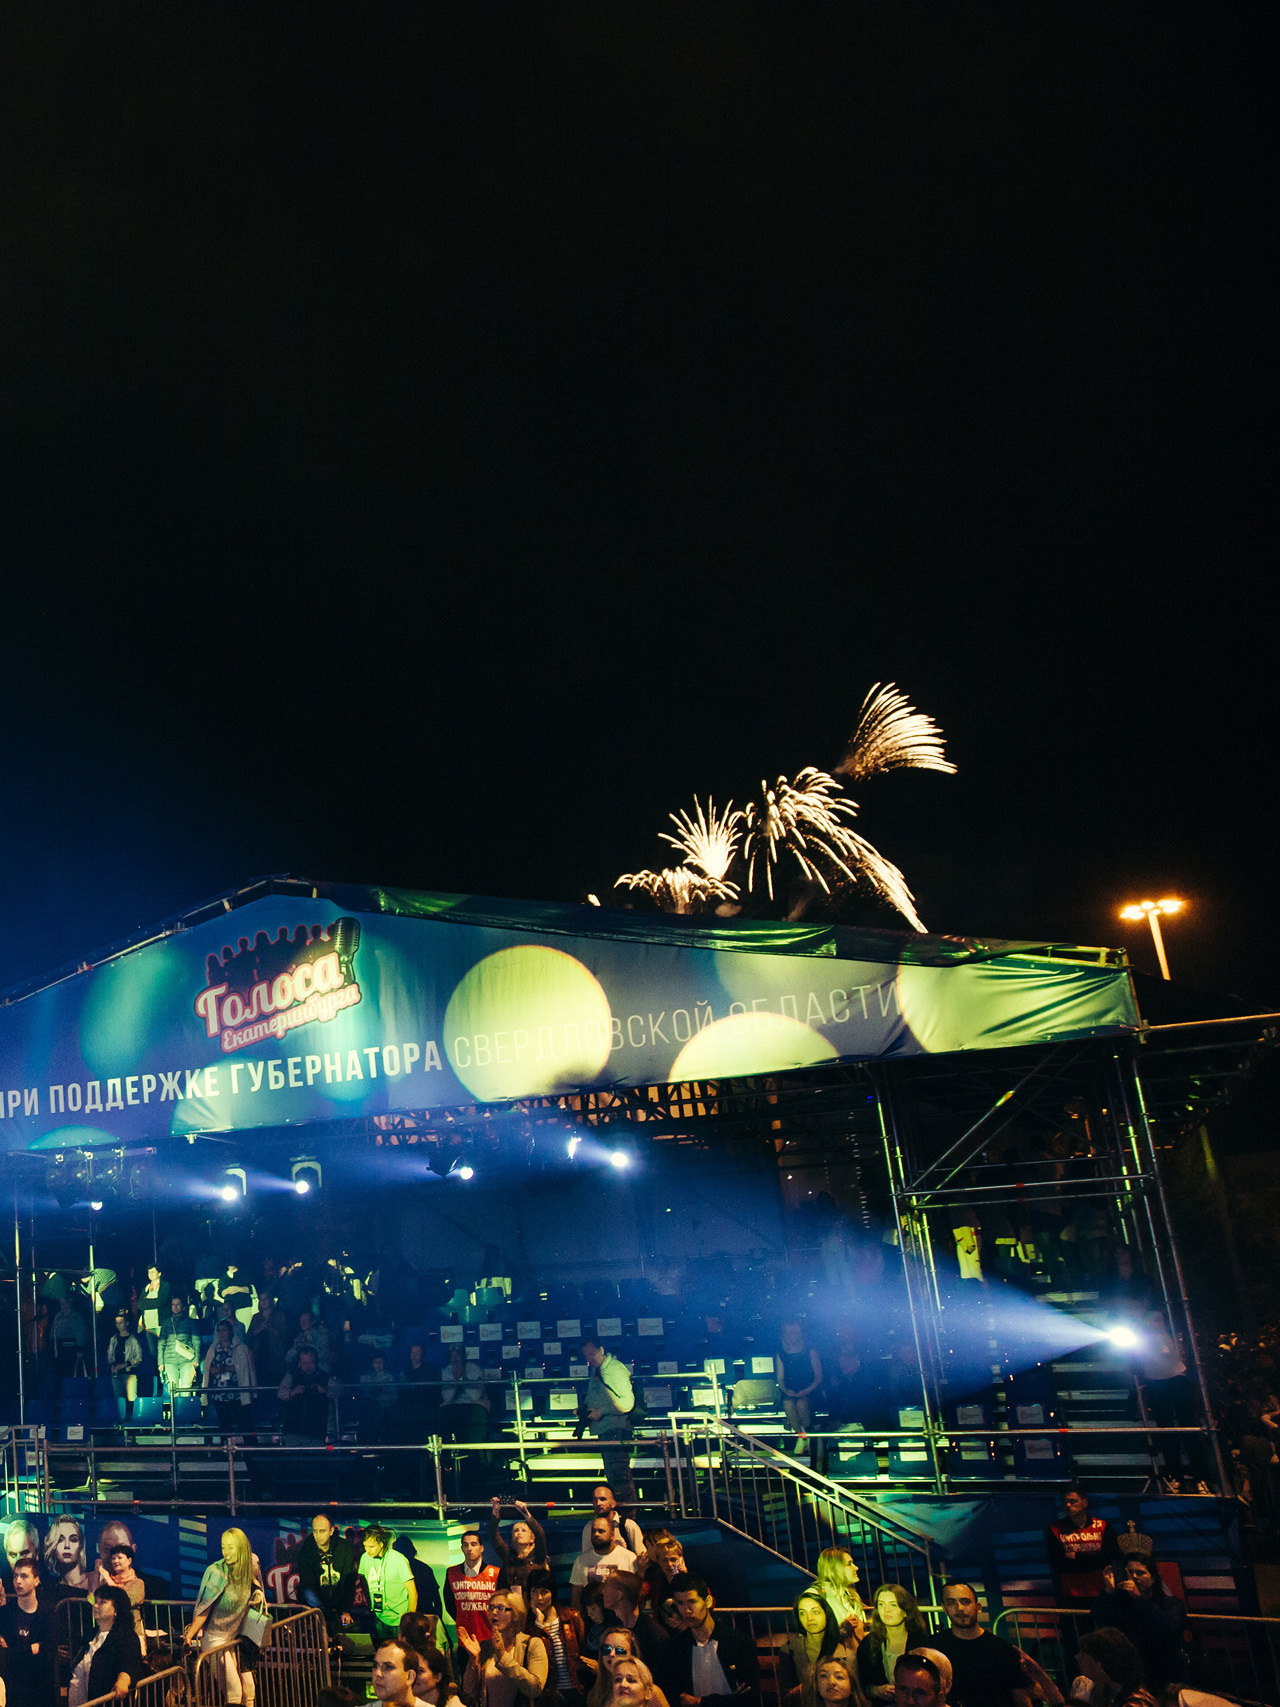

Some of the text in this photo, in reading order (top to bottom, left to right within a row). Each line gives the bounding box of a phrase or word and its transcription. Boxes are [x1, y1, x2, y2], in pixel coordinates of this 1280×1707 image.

[197, 952, 345, 1036] Голоса
[222, 986, 360, 1051] Екатеринбурга
[49, 1066, 221, 1114] ПОДДЕРЖКЕ
[230, 1040, 443, 1095] ГУБЕРНАТОРА
[454, 999, 714, 1069] СВЕРДЛОВСКОЙ
[729, 981, 902, 1036] ОБЛАСТИ
[488, 1567, 495, 1577] 9
[460, 1601, 487, 1611] СЛУЖБА
